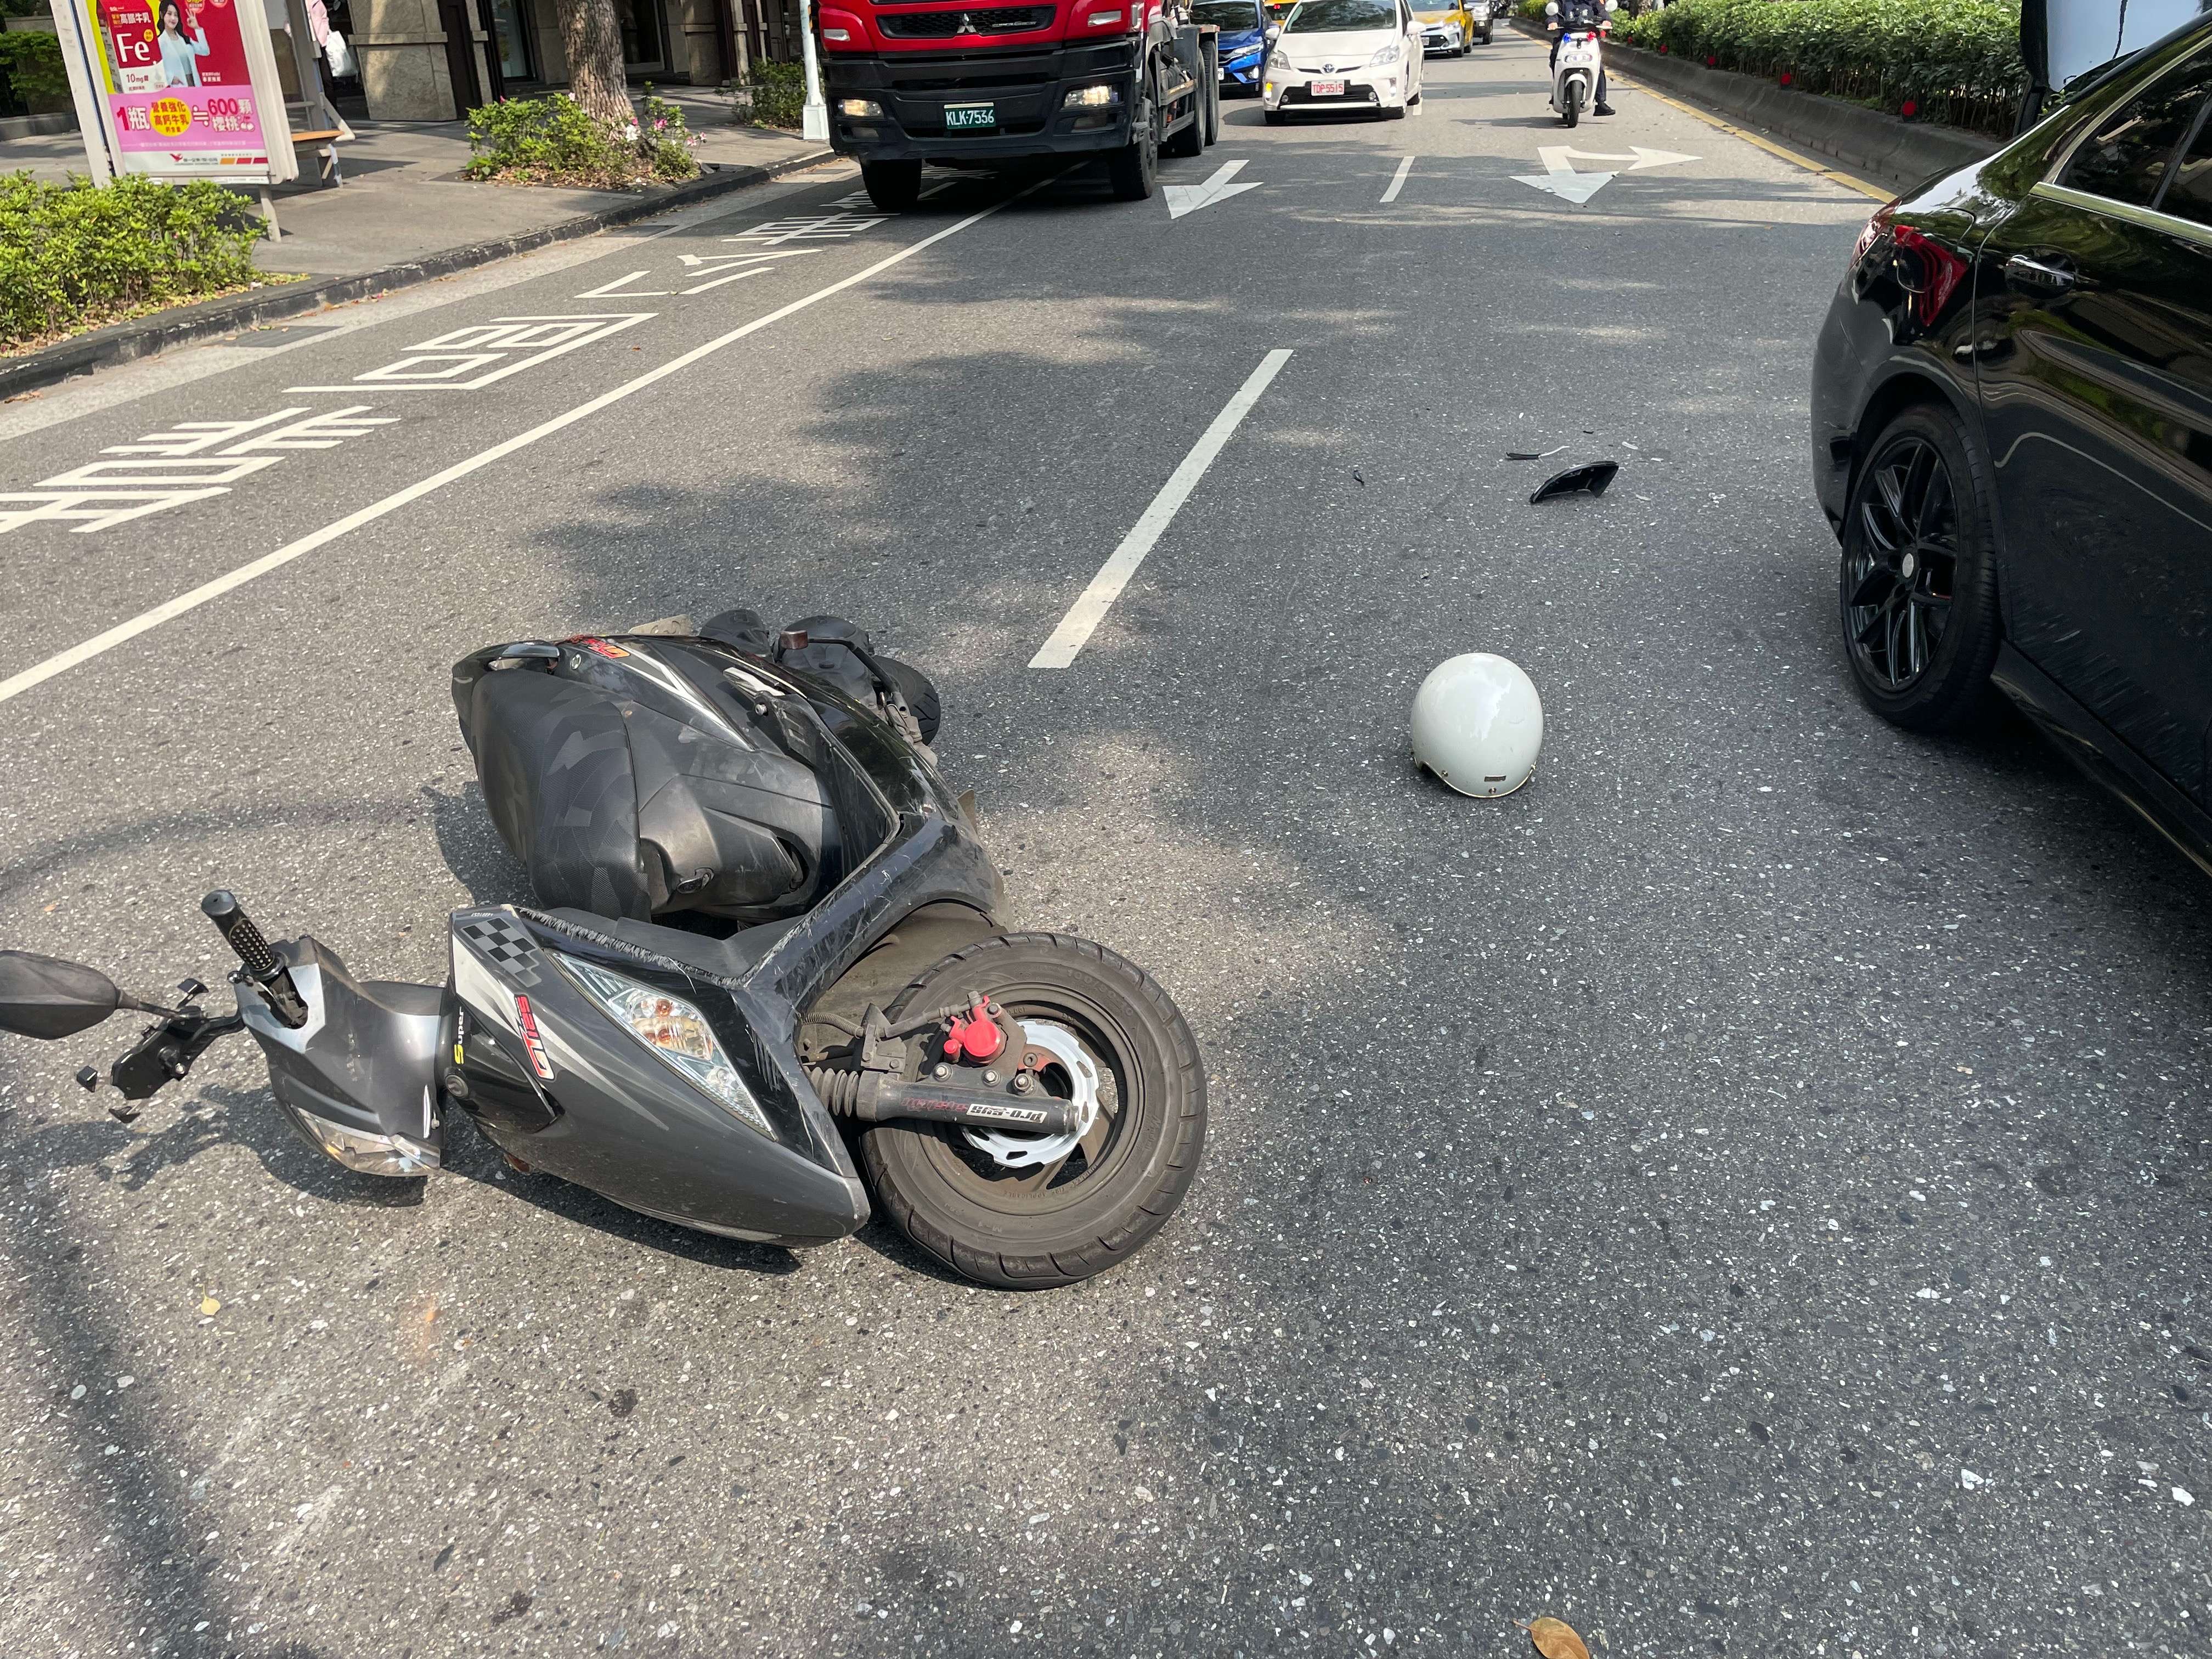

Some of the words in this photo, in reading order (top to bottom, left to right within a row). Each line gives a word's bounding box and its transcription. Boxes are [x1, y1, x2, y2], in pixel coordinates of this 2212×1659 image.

[116, 33, 150, 63] Fe
[116, 106, 150, 131] 1瓶
[454, 1007, 464, 1065] Super
